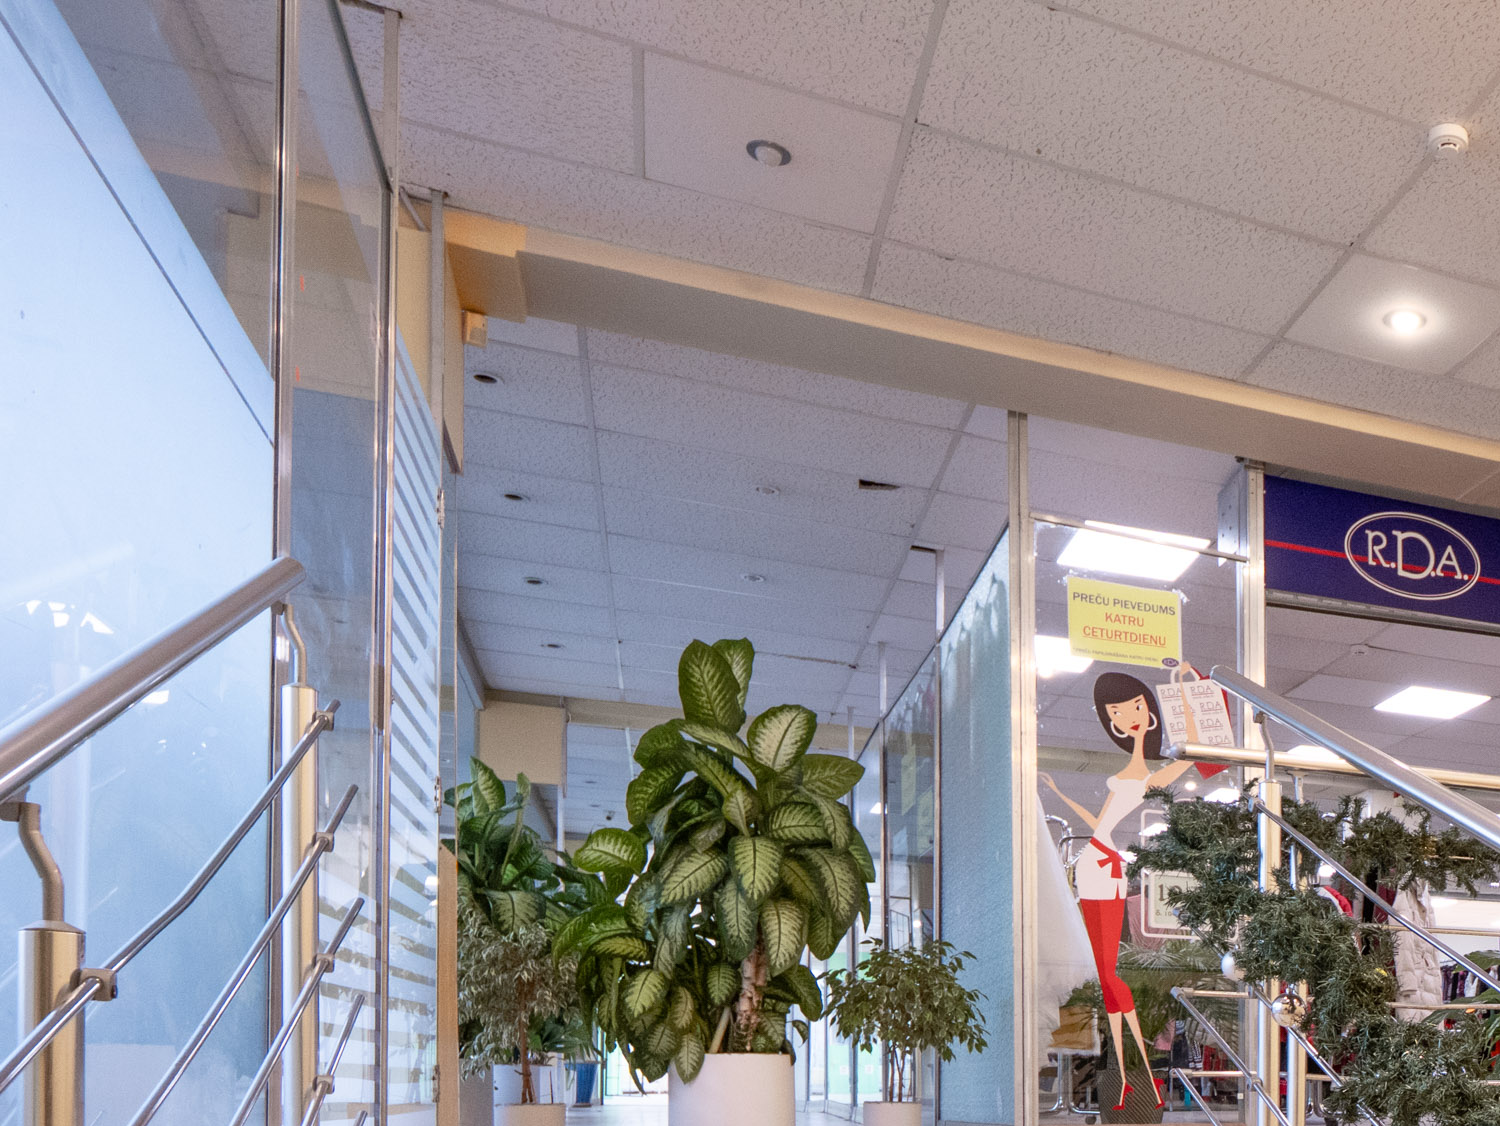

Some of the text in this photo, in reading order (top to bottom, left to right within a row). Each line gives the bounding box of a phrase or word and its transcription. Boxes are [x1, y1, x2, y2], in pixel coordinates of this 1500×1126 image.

[1072, 591, 1176, 616] PREČU PIEVEDUMS
[1105, 612, 1145, 627] KATRU
[1083, 625, 1167, 646] CETURTDIENU
